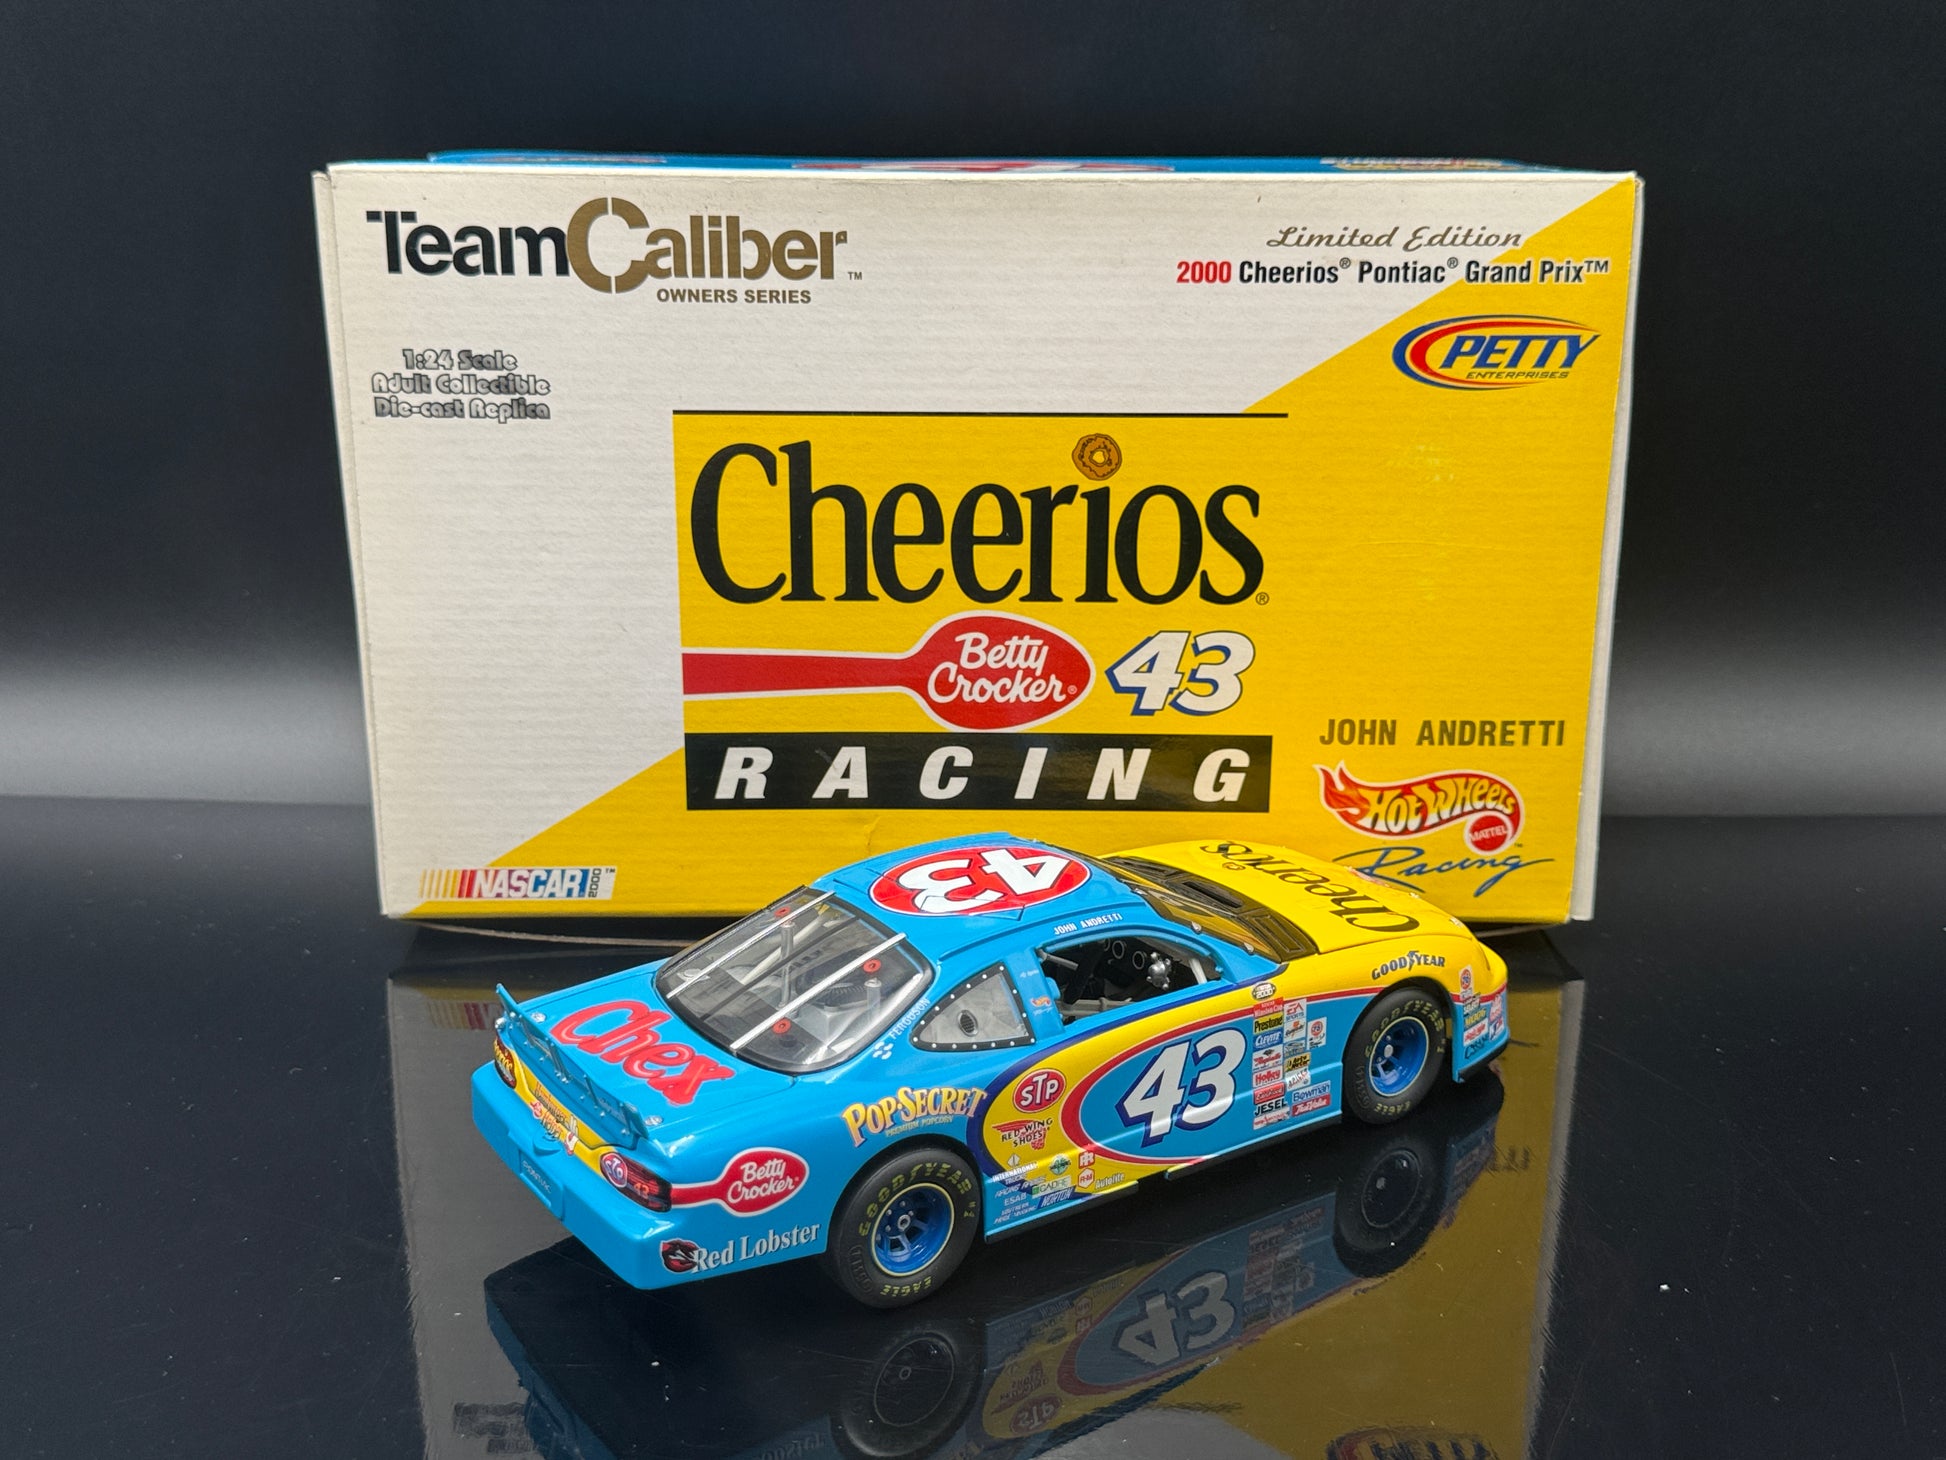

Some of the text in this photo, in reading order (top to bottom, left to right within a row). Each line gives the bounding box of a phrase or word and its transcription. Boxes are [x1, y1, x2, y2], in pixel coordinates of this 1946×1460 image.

[1266, 226, 1522, 252] Limited Edition
[1176, 261, 1232, 284] 2000
[1465, 260, 1531, 284] Grand
[656, 288, 812, 304] OWNERS SERIES
[402, 349, 518, 371] 1:24 Scale
[1438, 333, 1601, 369] PETTY
[371, 374, 552, 397] Adult Collectible
[1465, 371, 1570, 380] ENTERPRISES
[374, 399, 551, 424] Die-cast Replica
[690, 433, 1265, 606] Cheerios
[955, 631, 1050, 676] Betty
[927, 664, 1067, 705] Crocker
[1104, 629, 1257, 717] 43
[1319, 718, 1566, 747] JOHN ANDRETTI
[713, 745, 1252, 803] RACING
[1468, 824, 1509, 844] MATTEL
[471, 868, 584, 899] NASCAR
[588, 867, 602, 898] 2000
[898, 847, 1073, 914] 43
[1332, 846, 1556, 898] Racing
[1199, 840, 1421, 933] Cheerios
[1053, 912, 1123, 936] JOHN ANDRETTI
[1371, 950, 1446, 980] GOODYEAR
[888, 996, 932, 1040] FERGUSON
[1254, 1016, 1284, 1033] Prestone
[549, 999, 736, 1106] Chex
[1020, 1073, 1060, 1107] STP
[1115, 1027, 1247, 1149] 43
[1254, 1098, 1287, 1117] JESEL
[885, 1121, 919, 1138] PREMIUM
[1001, 1117, 1054, 1143] RED WING
[1013, 1130, 1043, 1149] SHOES
[740, 1157, 786, 1183] Betty
[727, 1178, 797, 1204] Crocker
[857, 1161, 974, 1238] GOODYEAR
[1004, 1192, 1028, 1206] ESAB
[1040, 1187, 1073, 1208] NORTON
[692, 1223, 821, 1274] Red Lobster
[880, 1275, 934, 1298] EAGLE
